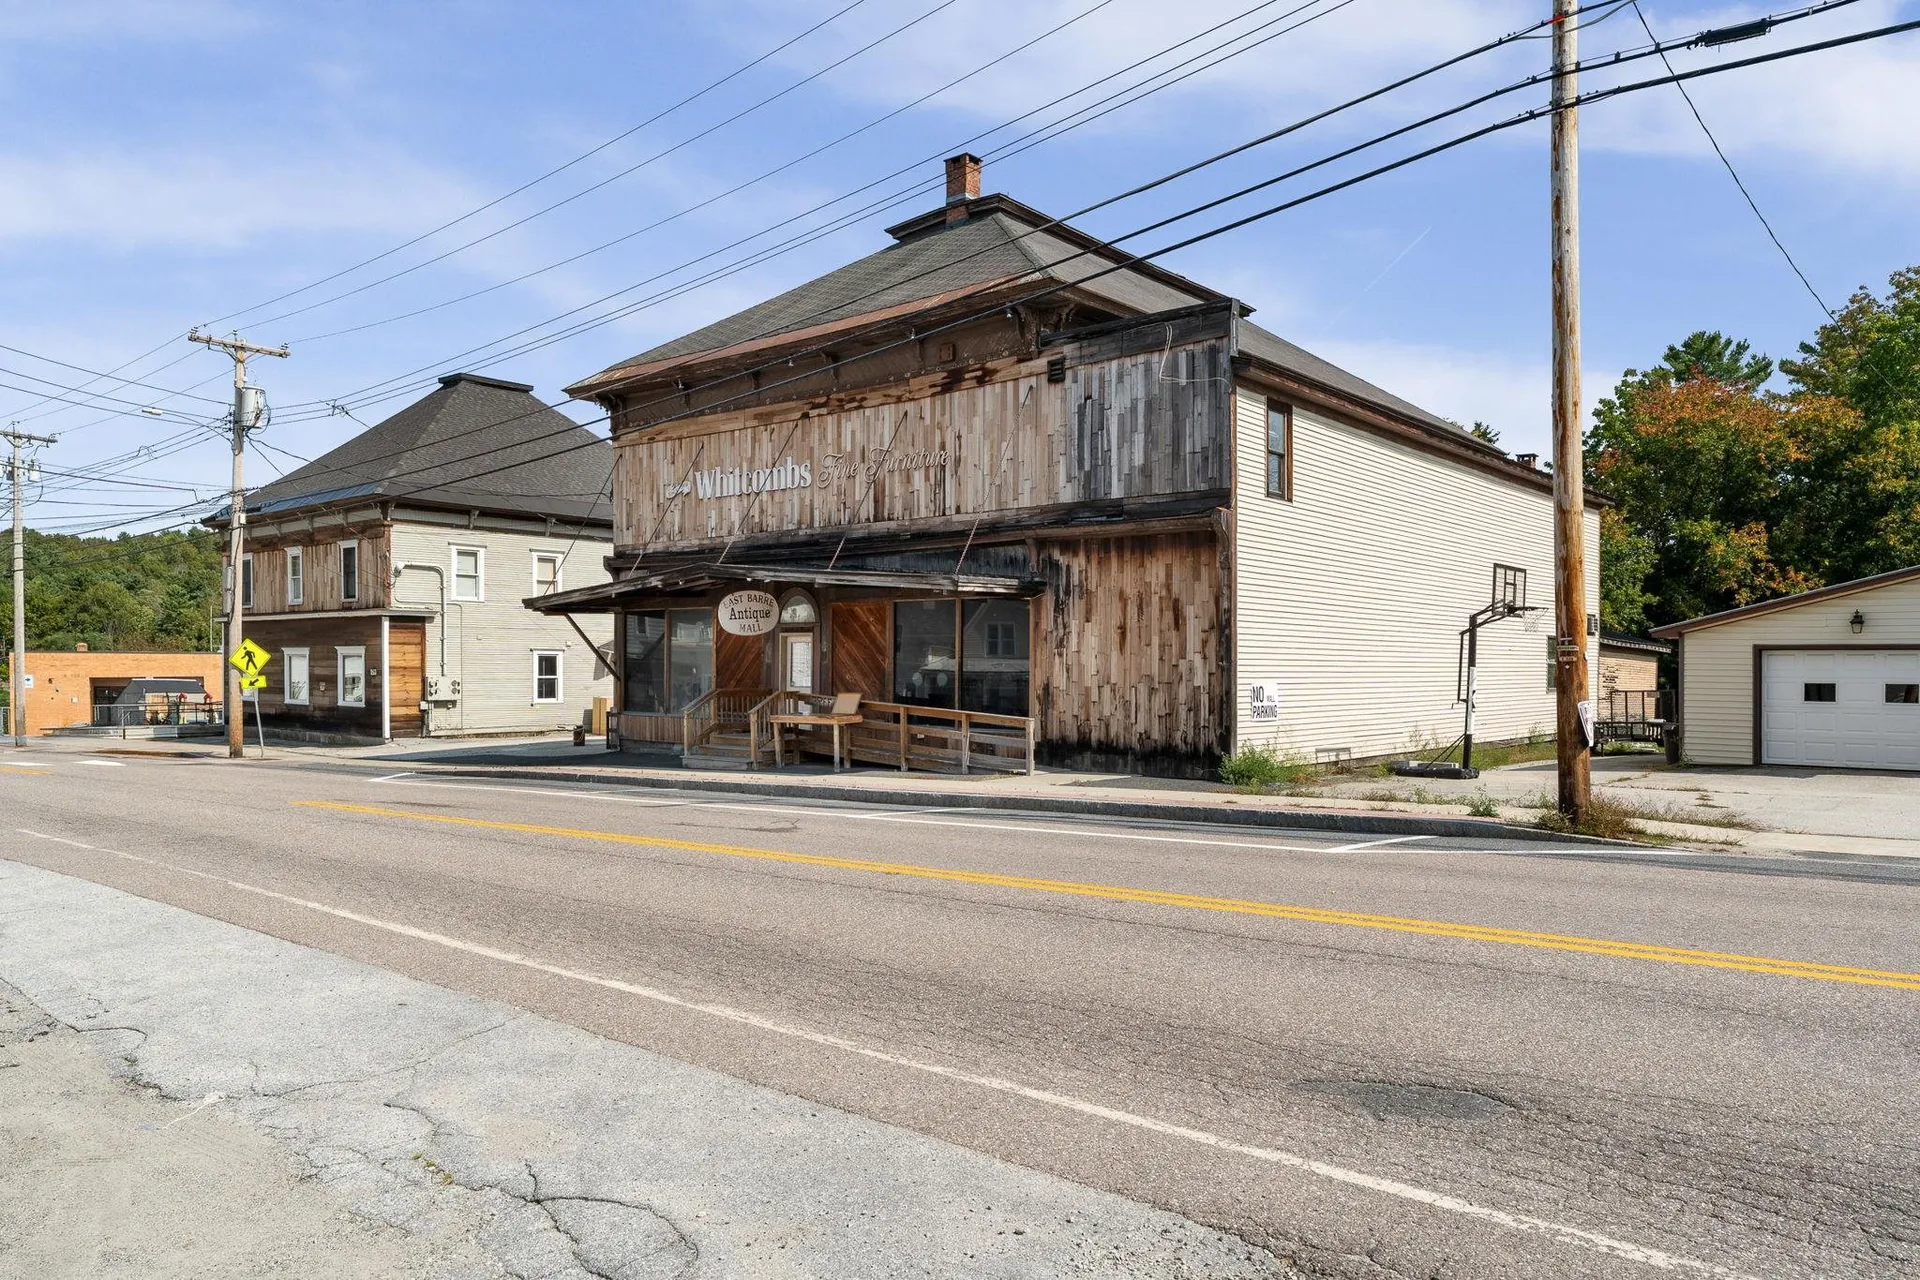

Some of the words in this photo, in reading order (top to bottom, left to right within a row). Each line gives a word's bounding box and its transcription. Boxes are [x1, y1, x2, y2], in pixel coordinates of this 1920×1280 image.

[694, 456, 812, 500] Whitcombs
[817, 453, 859, 489] Fine
[864, 447, 951, 484] Furniture
[721, 594, 743, 609] EAST
[747, 594, 775, 608] BARRE
[729, 607, 771, 623] Antique
[739, 623, 764, 633] MALL
[1252, 686, 1264, 702] NO
[1252, 704, 1277, 718] PARKING
